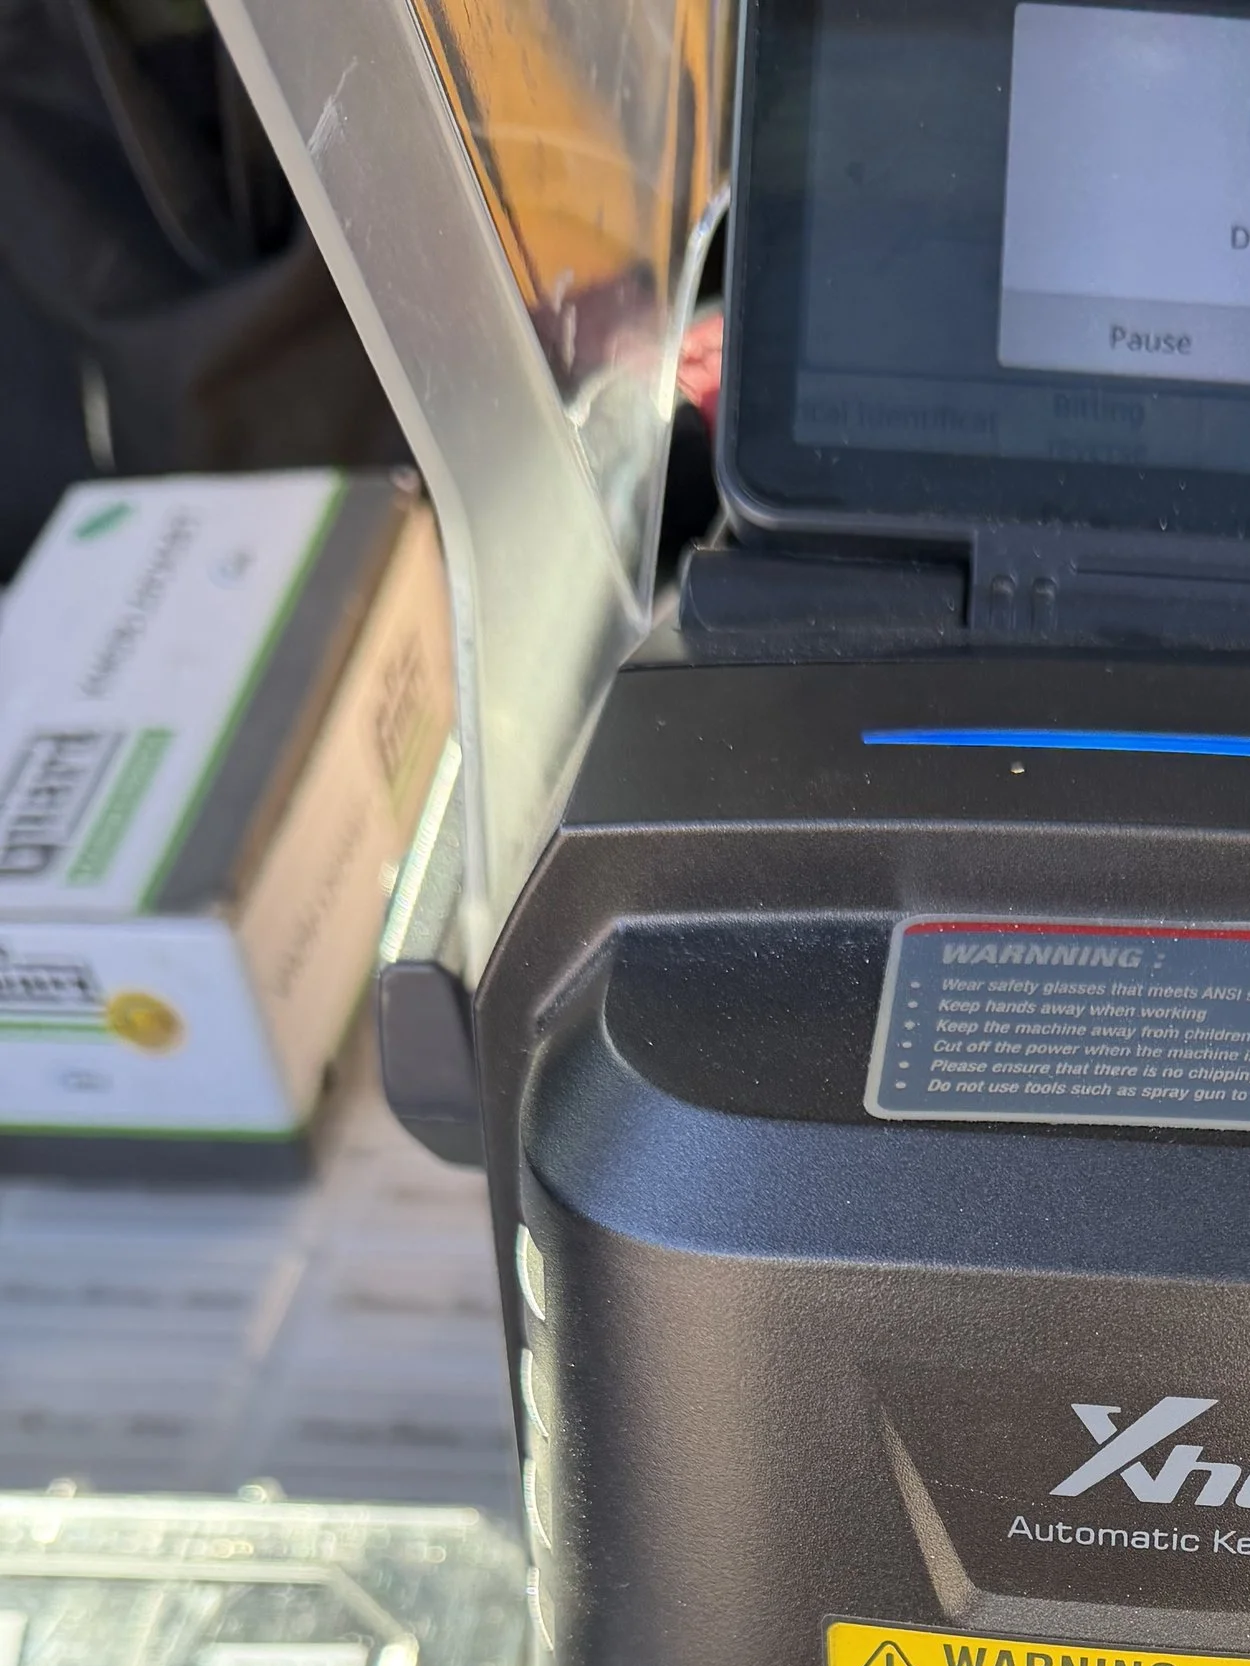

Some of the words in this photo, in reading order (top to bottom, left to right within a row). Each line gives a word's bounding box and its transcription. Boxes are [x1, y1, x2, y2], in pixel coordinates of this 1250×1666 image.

[1109, 324, 1193, 355] Pause
[942, 943, 1142, 968] WARNNING
[942, 979, 983, 991] Wear
[987, 979, 1039, 995] safety
[1043, 980, 1105, 996] glasses
[1111, 982, 1142, 997] that
[1148, 986, 1198, 999] meets
[1201, 987, 1241, 1000] ANSI
[938, 999, 980, 1014] Keep
[985, 999, 1036, 1014] hands
[1041, 1003, 1085, 1018] away
[1089, 1005, 1136, 1017] when
[1141, 1006, 1207, 1022] working
[936, 1018, 979, 1035] Keep
[984, 1020, 1010, 1034] the
[1015, 1021, 1087, 1036] machine
[1091, 1026, 1136, 1040] away
[1141, 1025, 1179, 1039] from
[1184, 1027, 1250, 1042] children
[933, 1039, 963, 1053] Cut
[966, 1039, 993, 1053] off
[994, 1041, 1022, 1054] the
[1025, 1044, 1080, 1056] power
[1084, 1044, 1131, 1057] when
[1136, 1045, 1163, 1058] the
[1167, 1046, 1239, 1061] machine
[930, 1059, 988, 1073] Please
[992, 1063, 1050, 1075] ensure
[1055, 1062, 1088, 1075] that
[1093, 1063, 1138, 1077] there
[1143, 1064, 1157, 1078] is
[1162, 1067, 1183, 1079] no
[927, 1079, 951, 1092] Do
[956, 1081, 985, 1093] not
[988, 1082, 1019, 1093] use
[1024, 1081, 1066, 1095] tools
[1071, 1082, 1111, 1096] such
[1117, 1086, 1136, 1097] as
[1141, 1086, 1189, 1102] spray
[1194, 1088, 1226, 1102] gun
[1232, 1089, 1248, 1101] to
[1007, 1515, 1201, 1554] Automatic
